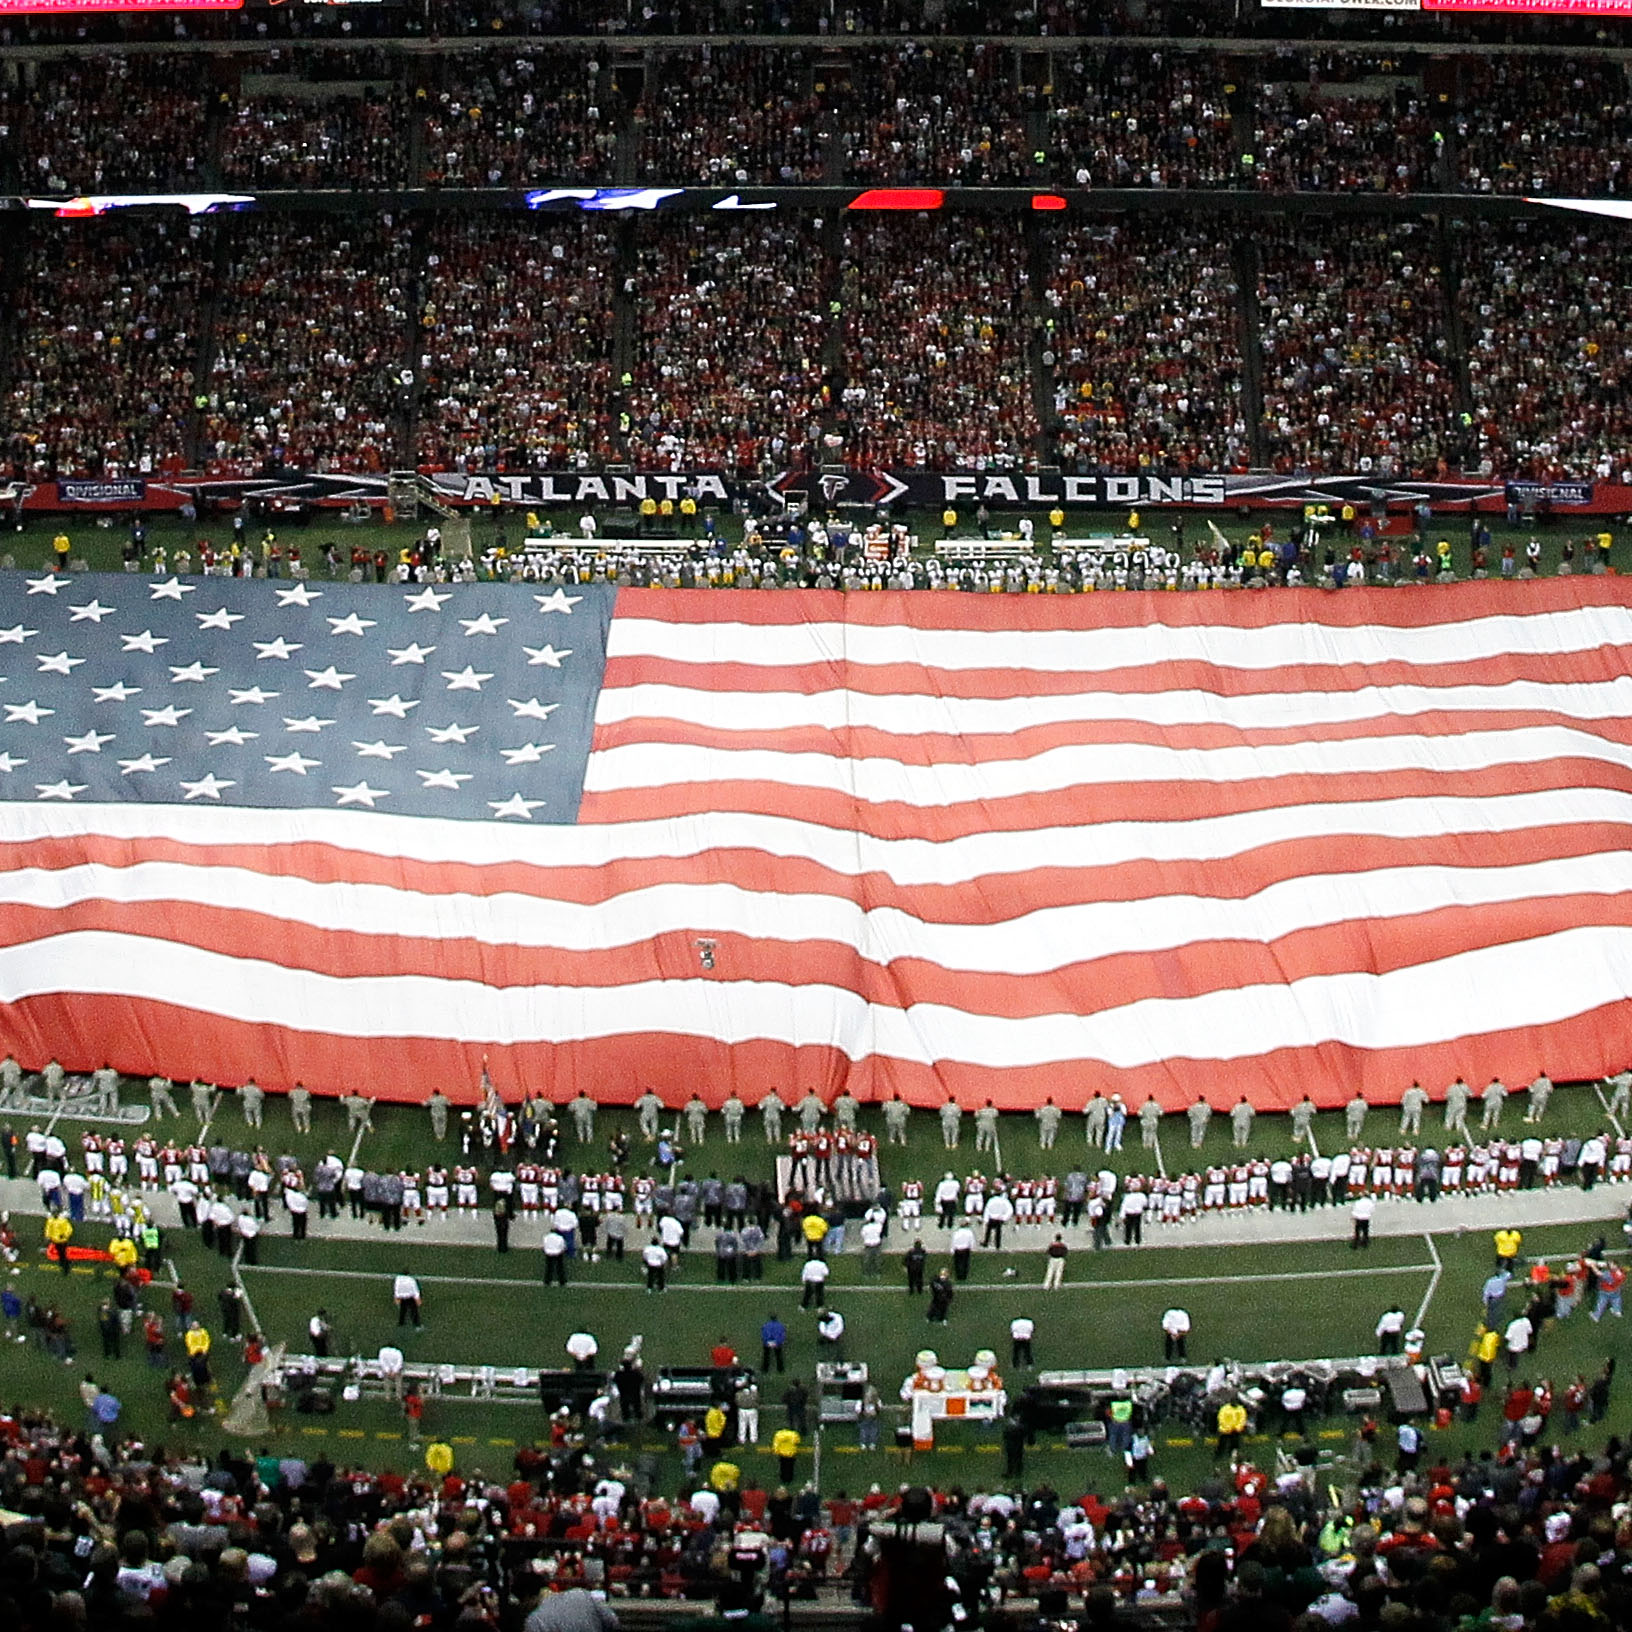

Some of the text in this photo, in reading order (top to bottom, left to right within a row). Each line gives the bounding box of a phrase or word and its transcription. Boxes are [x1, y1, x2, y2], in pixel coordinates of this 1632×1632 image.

[65, 483, 138, 498] DIVISIONAL
[464, 474, 730, 502] ATLANTA
[941, 474, 1226, 503] FALCONS
